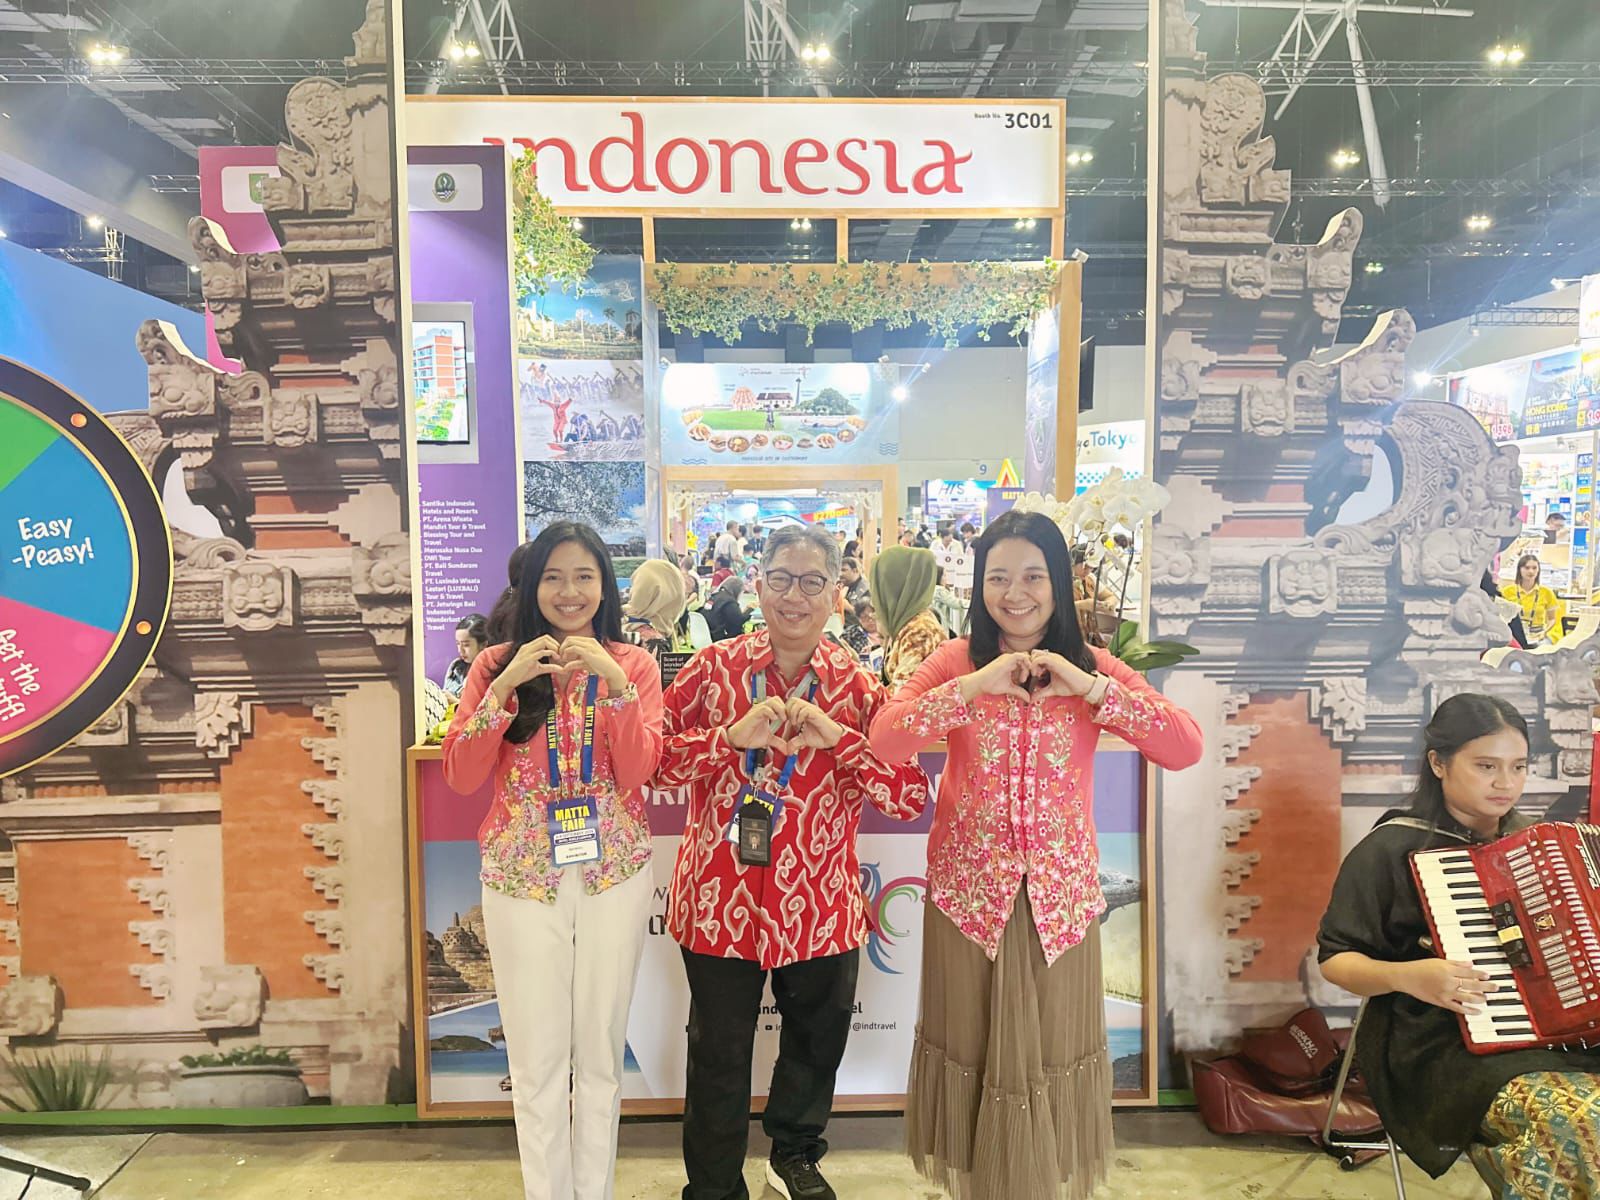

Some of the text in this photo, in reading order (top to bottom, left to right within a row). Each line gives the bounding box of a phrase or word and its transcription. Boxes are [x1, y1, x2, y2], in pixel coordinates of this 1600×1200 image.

[1005, 112, 1053, 129] 3C01
[482, 111, 973, 196] ndonesia
[979, 464, 988, 475] 9
[18, 517, 72, 541] Easy
[12, 537, 95, 569] -Peasy!
[10, 663, 40, 696] the
[547, 725, 557, 750] MATTA
[583, 705, 595, 746] MATTA FAIR
[554, 805, 591, 821] MATTA
[562, 818, 586, 832] FAIR
[852, 1021, 896, 1031] @indtravel
